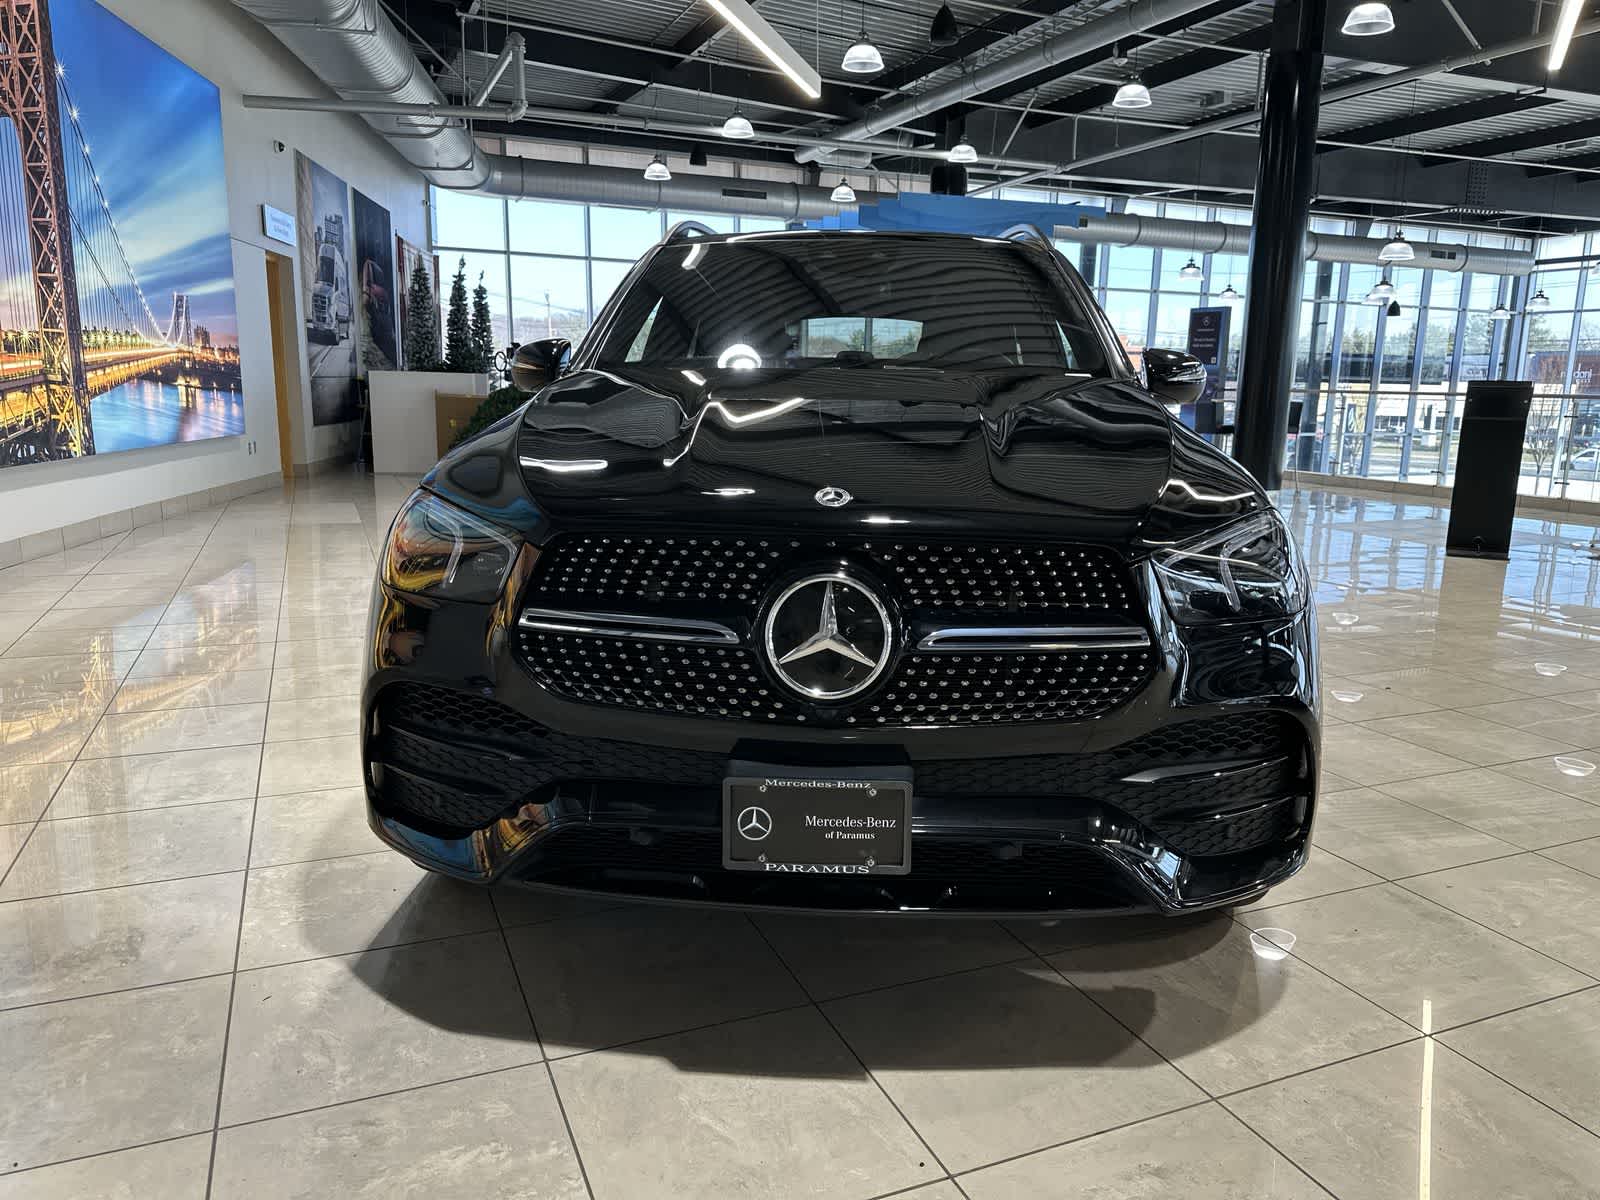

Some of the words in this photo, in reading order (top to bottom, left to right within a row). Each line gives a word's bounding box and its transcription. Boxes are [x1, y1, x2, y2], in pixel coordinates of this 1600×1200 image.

[765, 779, 872, 789] Mercedes-Benz
[805, 815, 897, 829] Mercedes-Benz
[825, 831, 834, 840] of
[836, 831, 876, 840] Paramus
[764, 863, 870, 874] PARAMUS
